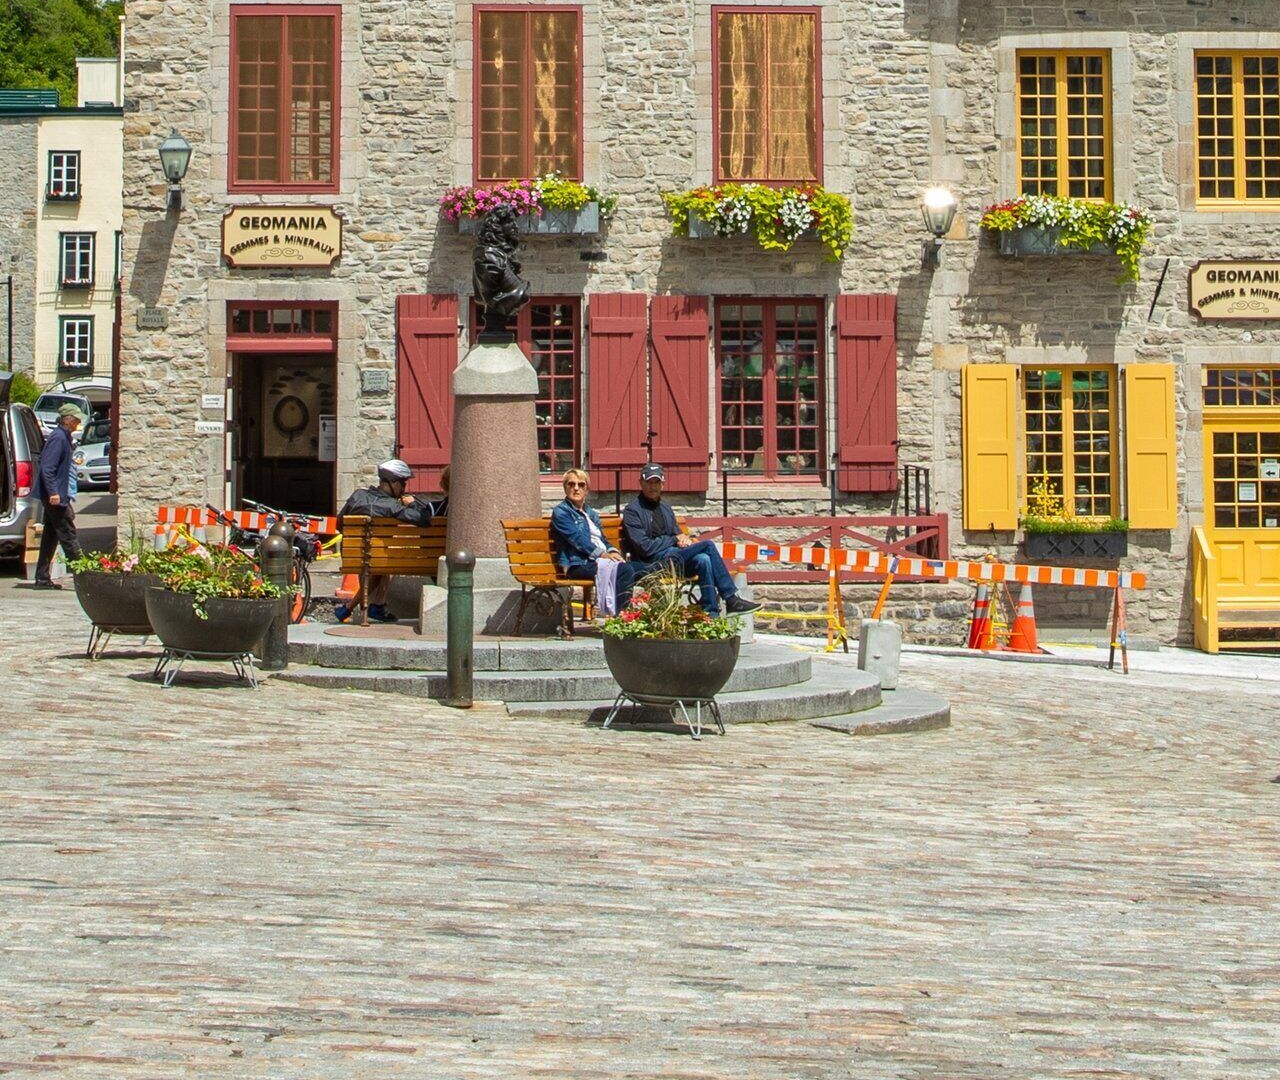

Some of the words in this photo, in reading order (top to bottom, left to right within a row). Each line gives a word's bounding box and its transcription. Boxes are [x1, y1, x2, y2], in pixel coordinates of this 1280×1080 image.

[240, 216, 327, 230] GEOMANIA
[230, 235, 269, 256] GEMMES
[273, 235, 280, 244] &
[285, 235, 335, 256] MINERAUX
[1198, 288, 1236, 308] GEMMES
[1239, 288, 1246, 297] &
